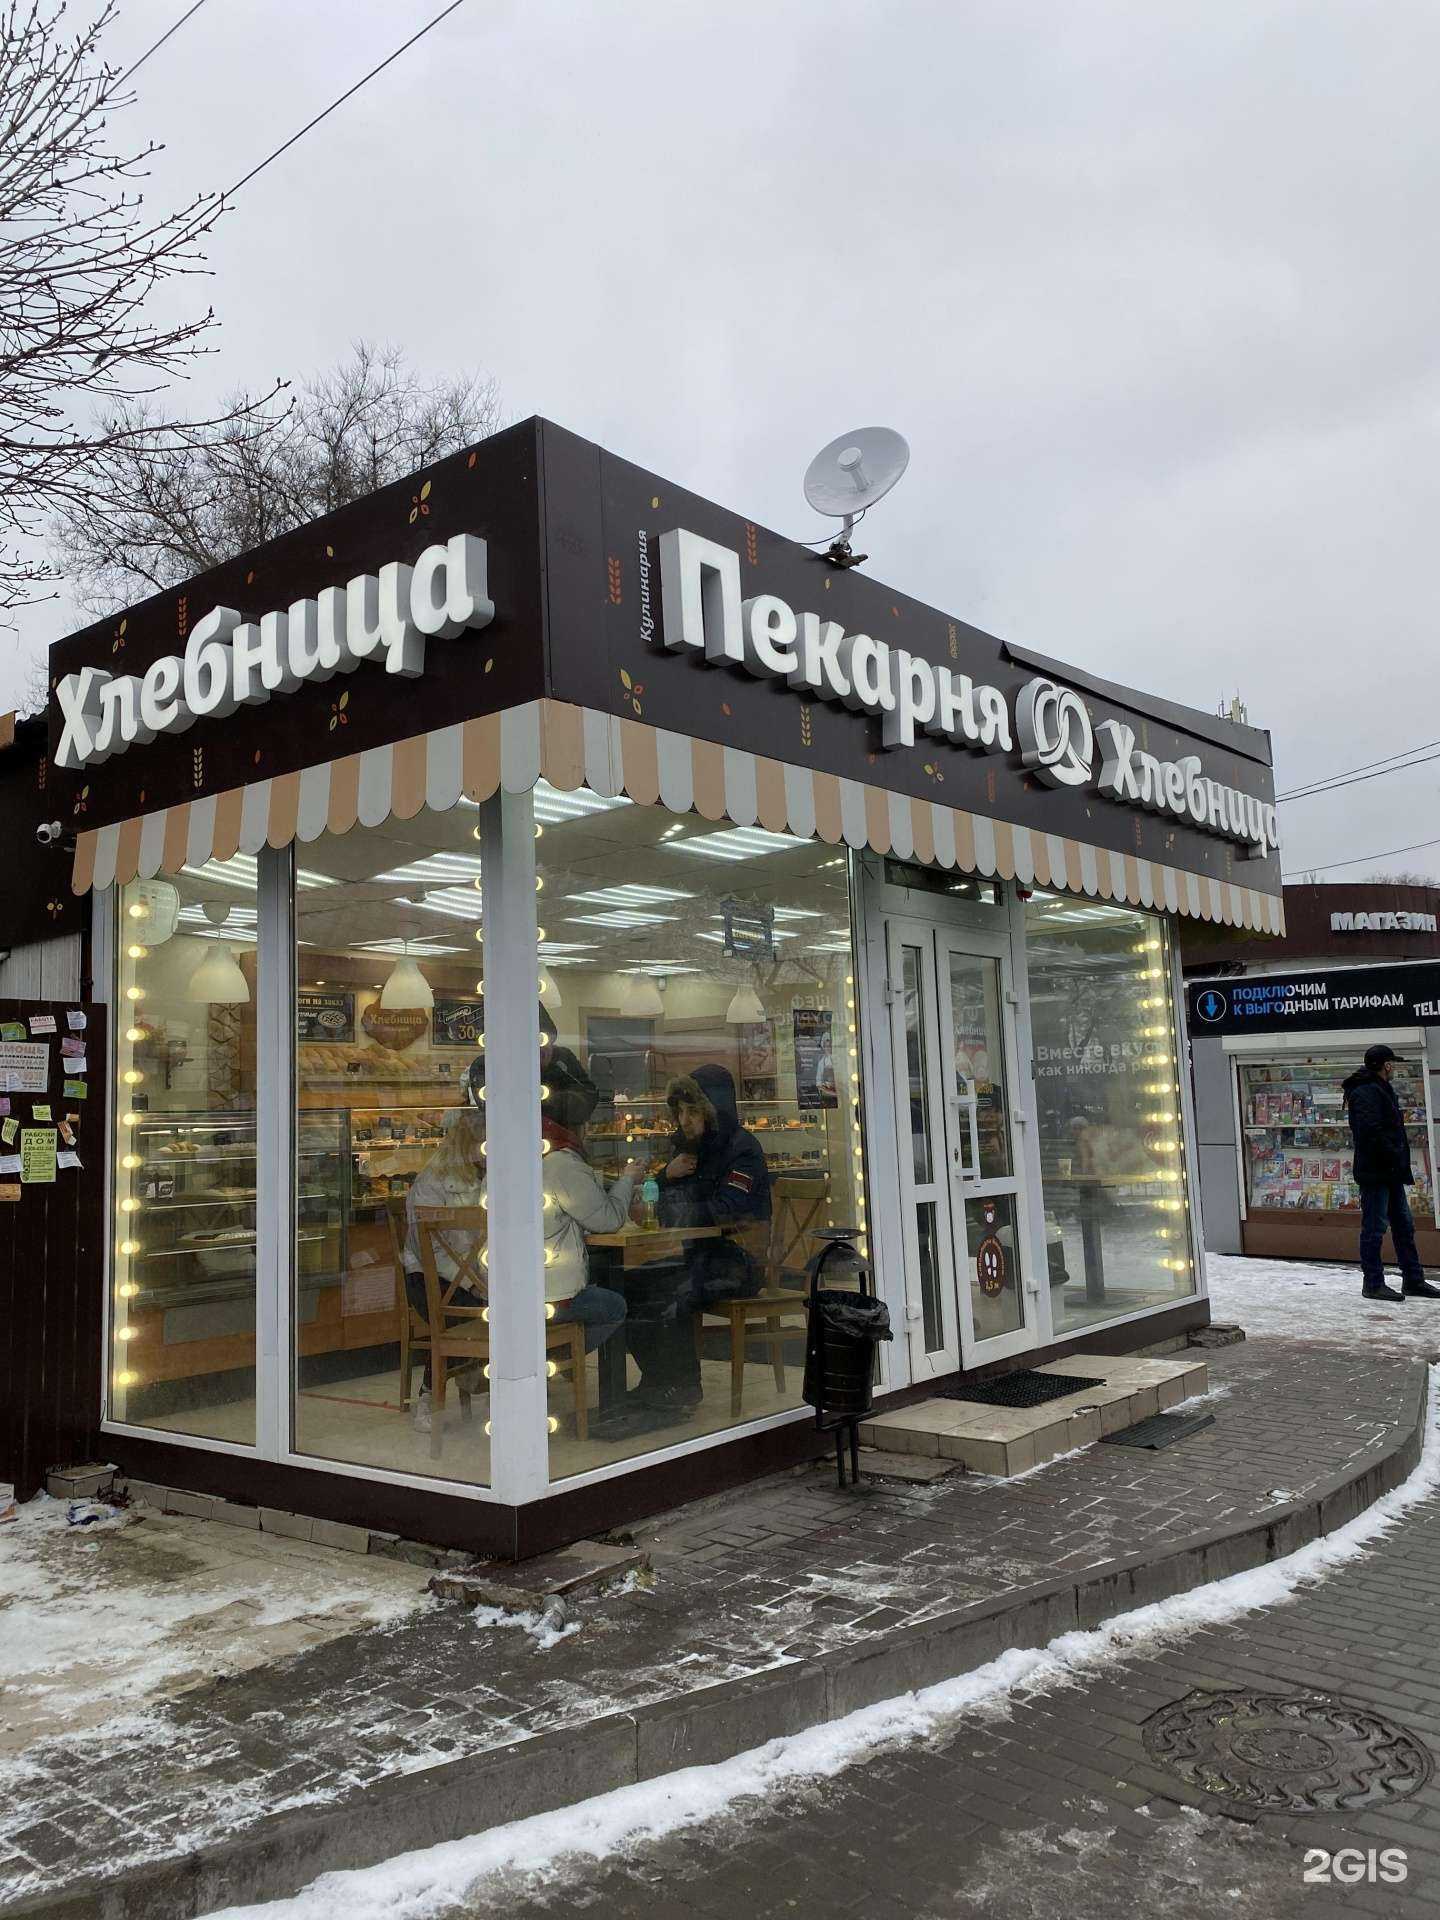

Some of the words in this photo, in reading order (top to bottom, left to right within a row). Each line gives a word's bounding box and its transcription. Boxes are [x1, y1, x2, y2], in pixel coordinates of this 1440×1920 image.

[639, 529, 655, 642] Кулинария
[55, 533, 494, 769] Хлебница
[659, 528, 1013, 752] Пекарня
[1095, 719, 1280, 859] Хлебница
[1233, 983, 1327, 1000] ПОДКЛЮЧИМ
[1234, 1004, 1242, 1016] К
[1245, 998, 1329, 1016] ВЫГОДНЫМ
[1332, 994, 1404, 1010] ТАРИФАМ
[1413, 1000, 1440, 1016] TEL
[1037, 1044, 1105, 1061] Вместе
[1066, 1062, 1127, 1075] никогда
